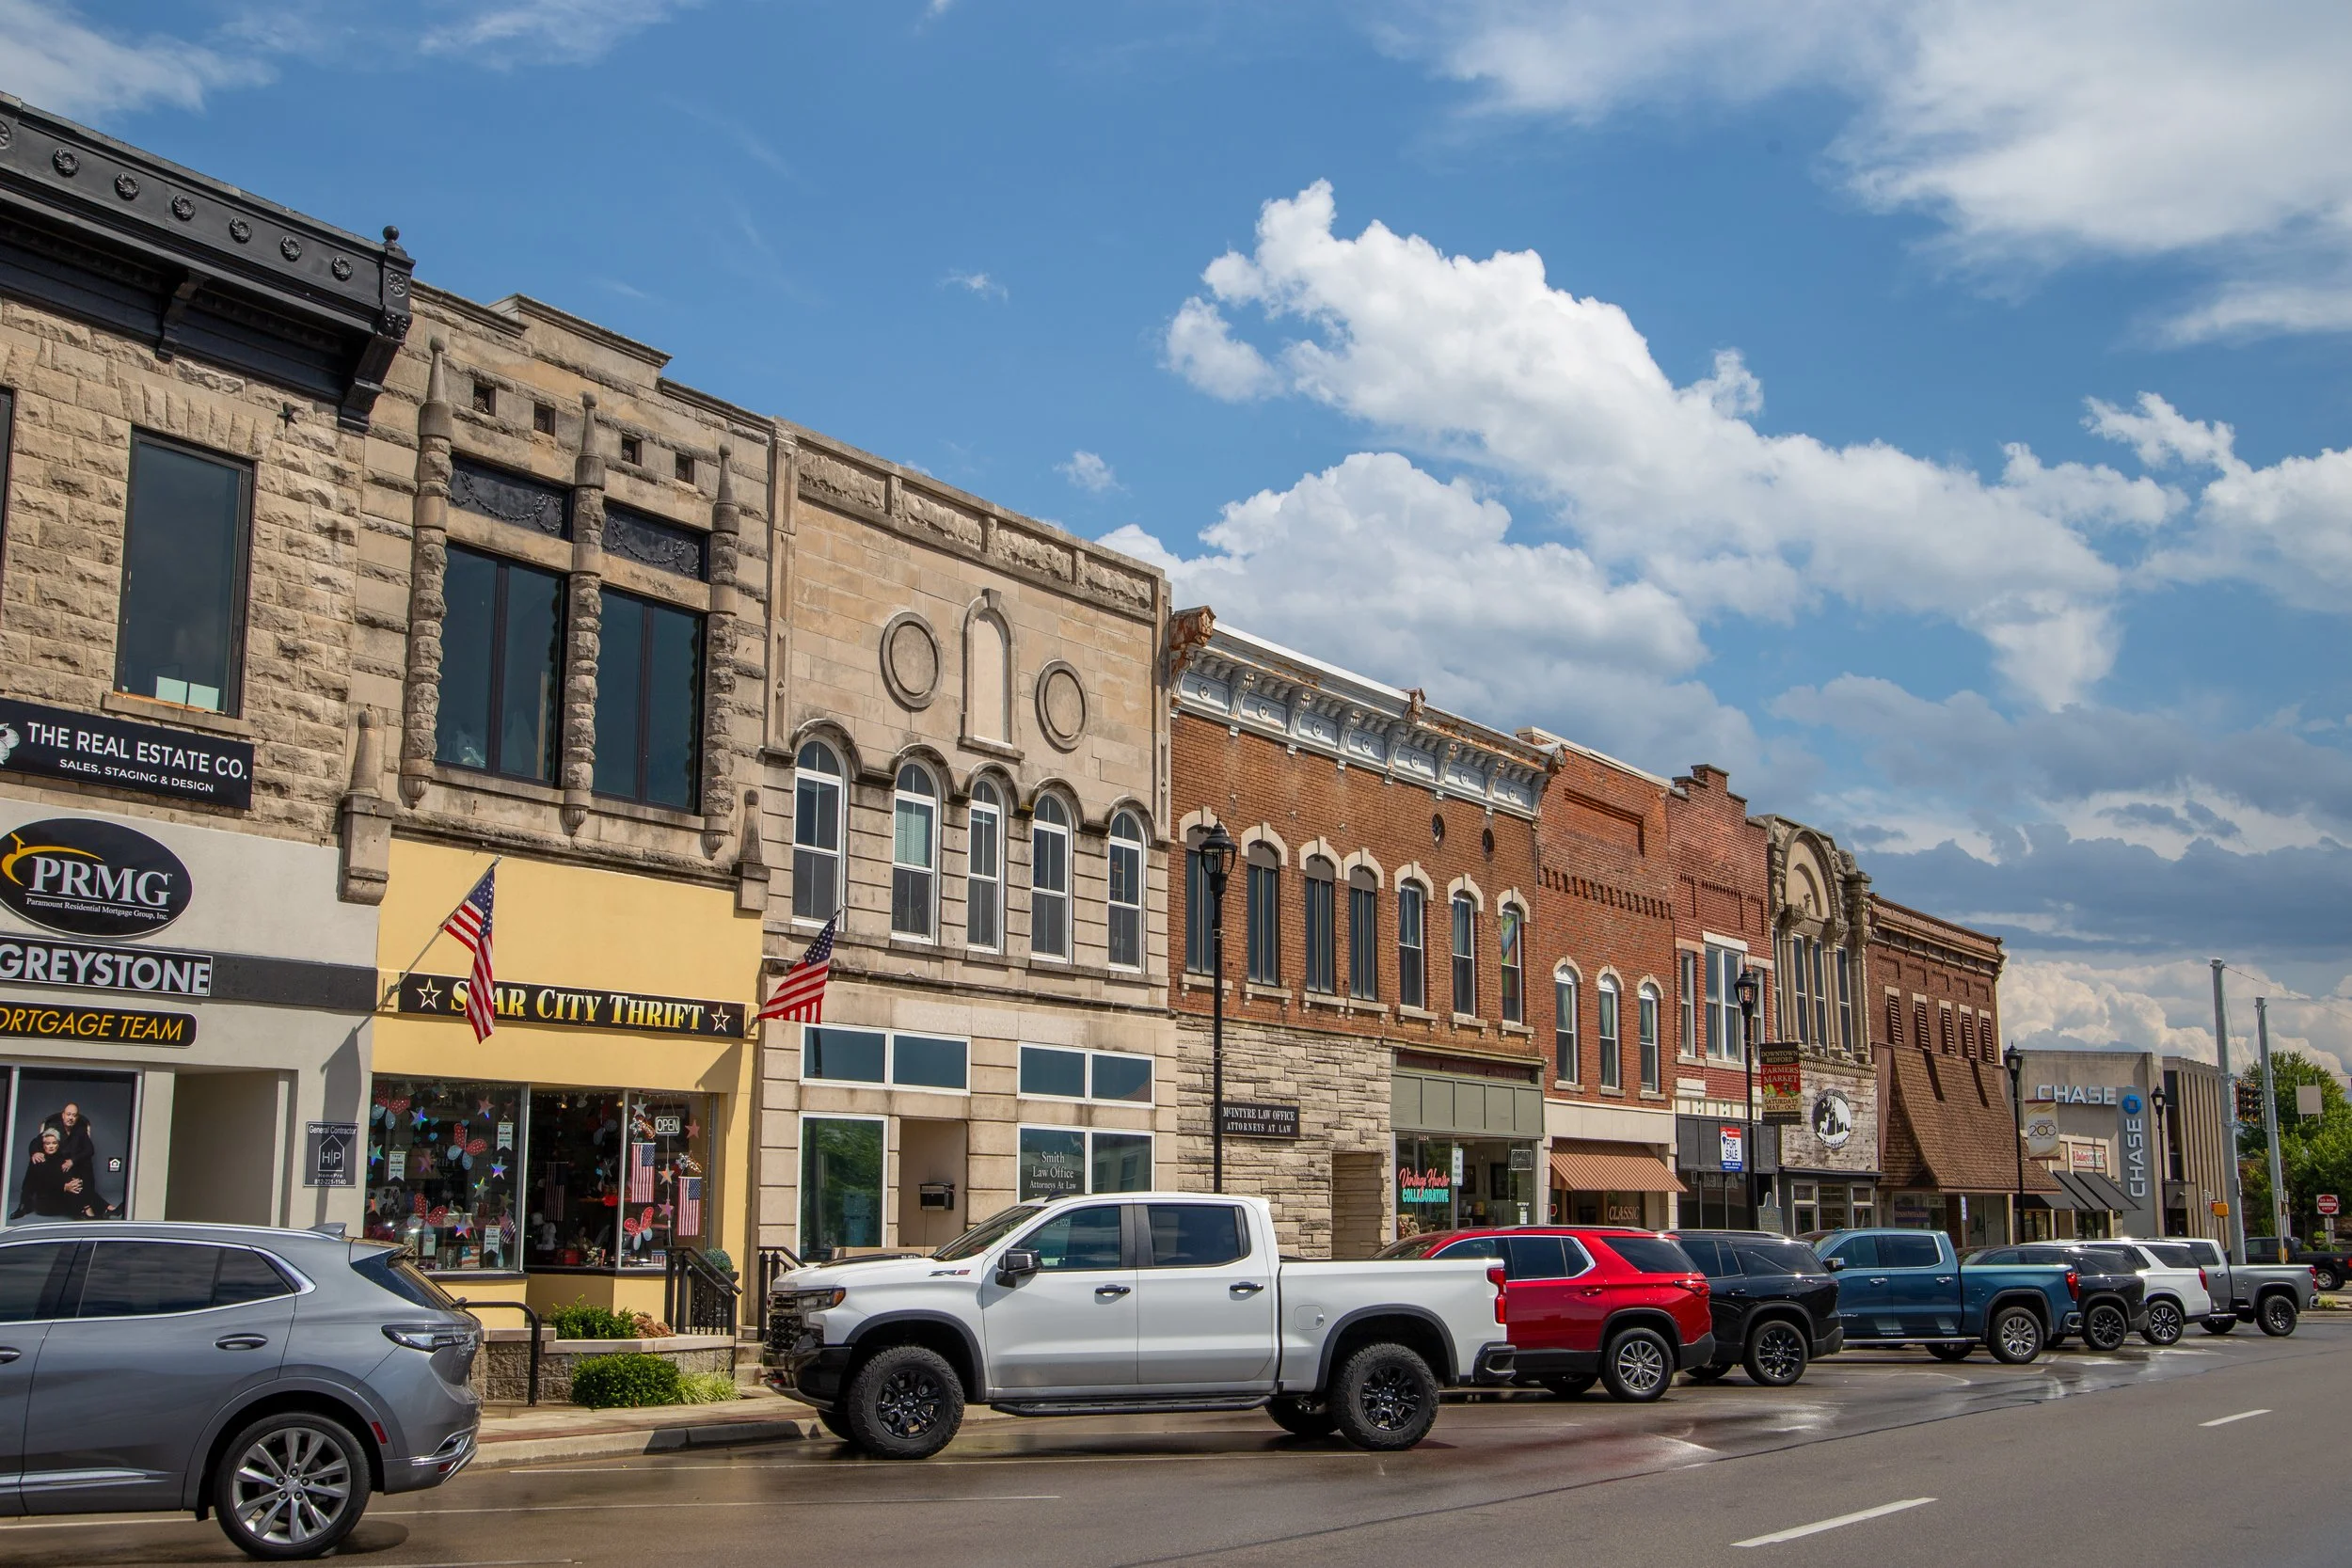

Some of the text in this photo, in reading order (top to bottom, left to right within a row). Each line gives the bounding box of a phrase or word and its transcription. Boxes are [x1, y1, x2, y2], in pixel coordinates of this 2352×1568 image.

[27, 721, 247, 780] THE REAL ESTATE CO.
[59, 759, 214, 793] SALES, STAGING & DESIGN
[28, 856, 170, 907] PRMG
[26, 897, 168, 921] Paramount Residential Mortgage Group, Inc.
[0, 943, 210, 994] GREYSTONE
[451, 980, 704, 1030] SAR CITY THRIFT
[119, 1015, 183, 1041] TEAM
[1762, 1067, 1799, 1075] FARMERS
[1763, 1074, 1799, 1084] MARKET
[2036, 1085, 2117, 1105] CHASE
[1258, 1109, 1271, 1119] LAW
[1273, 1110, 1295, 1121] OFFICE
[309, 1125, 357, 1134] General Contractor
[657, 1118, 678, 1132] OPEN
[1226, 1122, 1292, 1133] ATTORNEYS AT LAW
[1725, 1138, 1737, 1148] FOR
[1041, 1151, 1065, 1164] Smith
[1725, 1149, 1738, 1160] SALE
[2126, 1118, 2146, 1197] CHASE
[1032, 1166, 1074, 1179] Law Office
[1029, 1180, 1056, 1192] Attorneys
[1066, 1181, 1076, 1190] Law
[1402, 1188, 1449, 1203] COLLABORATIVE
[1609, 1206, 1640, 1220] CLASSIC
